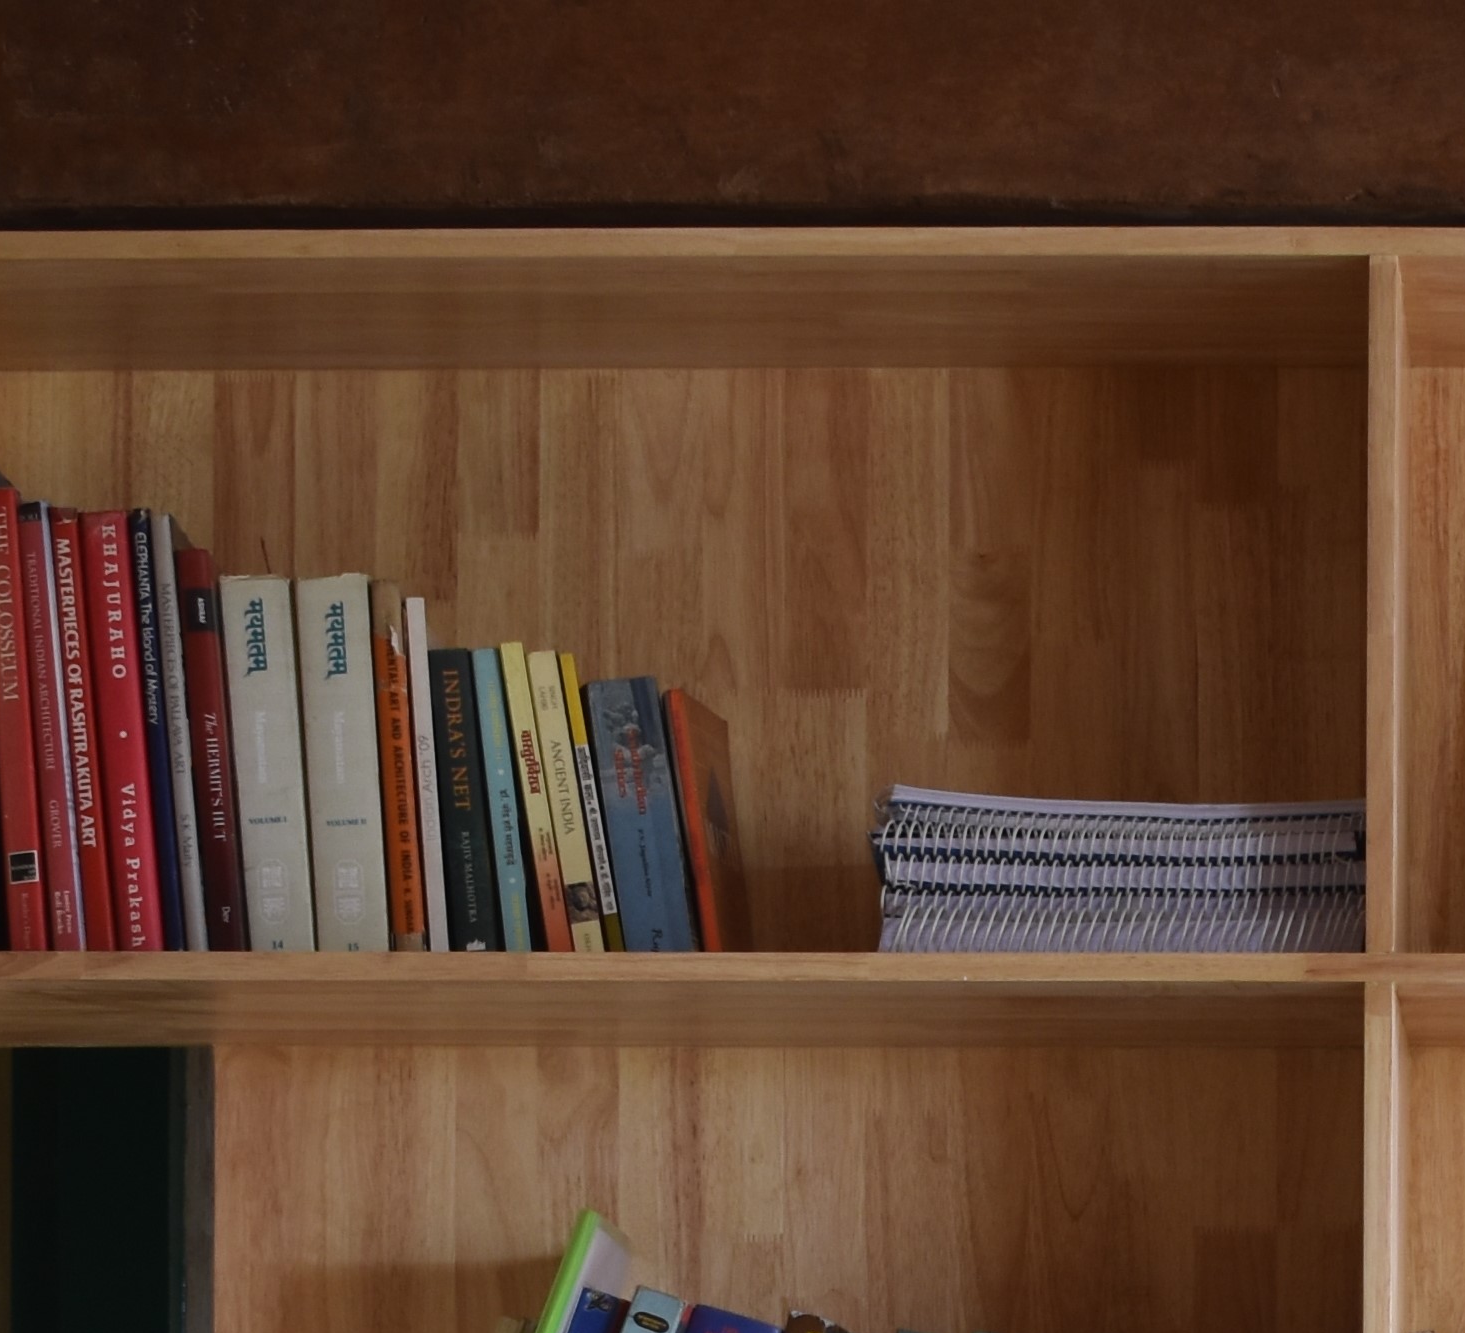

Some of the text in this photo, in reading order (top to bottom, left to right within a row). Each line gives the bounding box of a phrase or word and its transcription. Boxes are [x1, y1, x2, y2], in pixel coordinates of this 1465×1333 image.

[98, 524, 126, 679] KHAJURAHO
[134, 531, 160, 724] ELEPHANTA The Island of Mystery
[56, 537, 96, 848] MASTERPIECES OF RASHTRAKUTA ART
[204, 712, 226, 842] The HERMIT'S HUT
[249, 817, 281, 825] VOLUME
[441, 669, 477, 922] INDRA'S NET RAJIV MALHOTRA
[548, 738, 576, 834] ANCIENT INDIA
[117, 783, 146, 947] Vidya Prakash
[273, 940, 283, 949] 14
